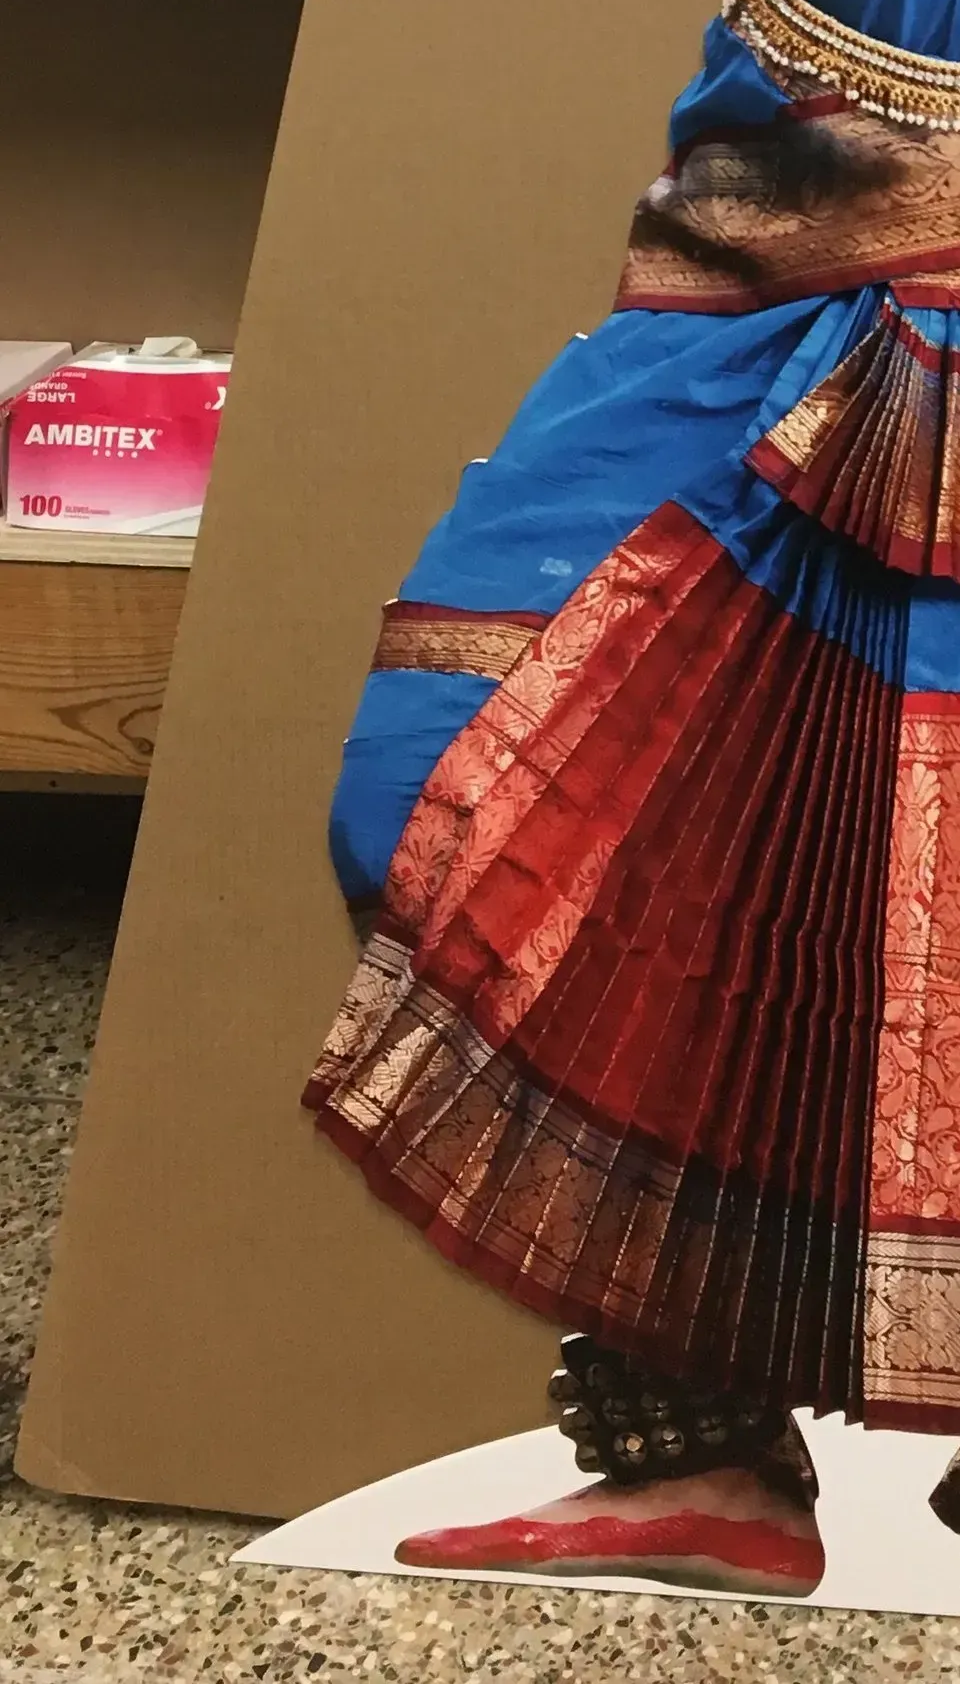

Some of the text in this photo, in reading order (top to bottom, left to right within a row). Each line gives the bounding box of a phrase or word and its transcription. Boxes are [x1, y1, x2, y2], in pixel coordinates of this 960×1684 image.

[27, 391, 76, 403] LARGE
[24, 423, 156, 450] AMBITEX
[19, 494, 62, 517] 100
